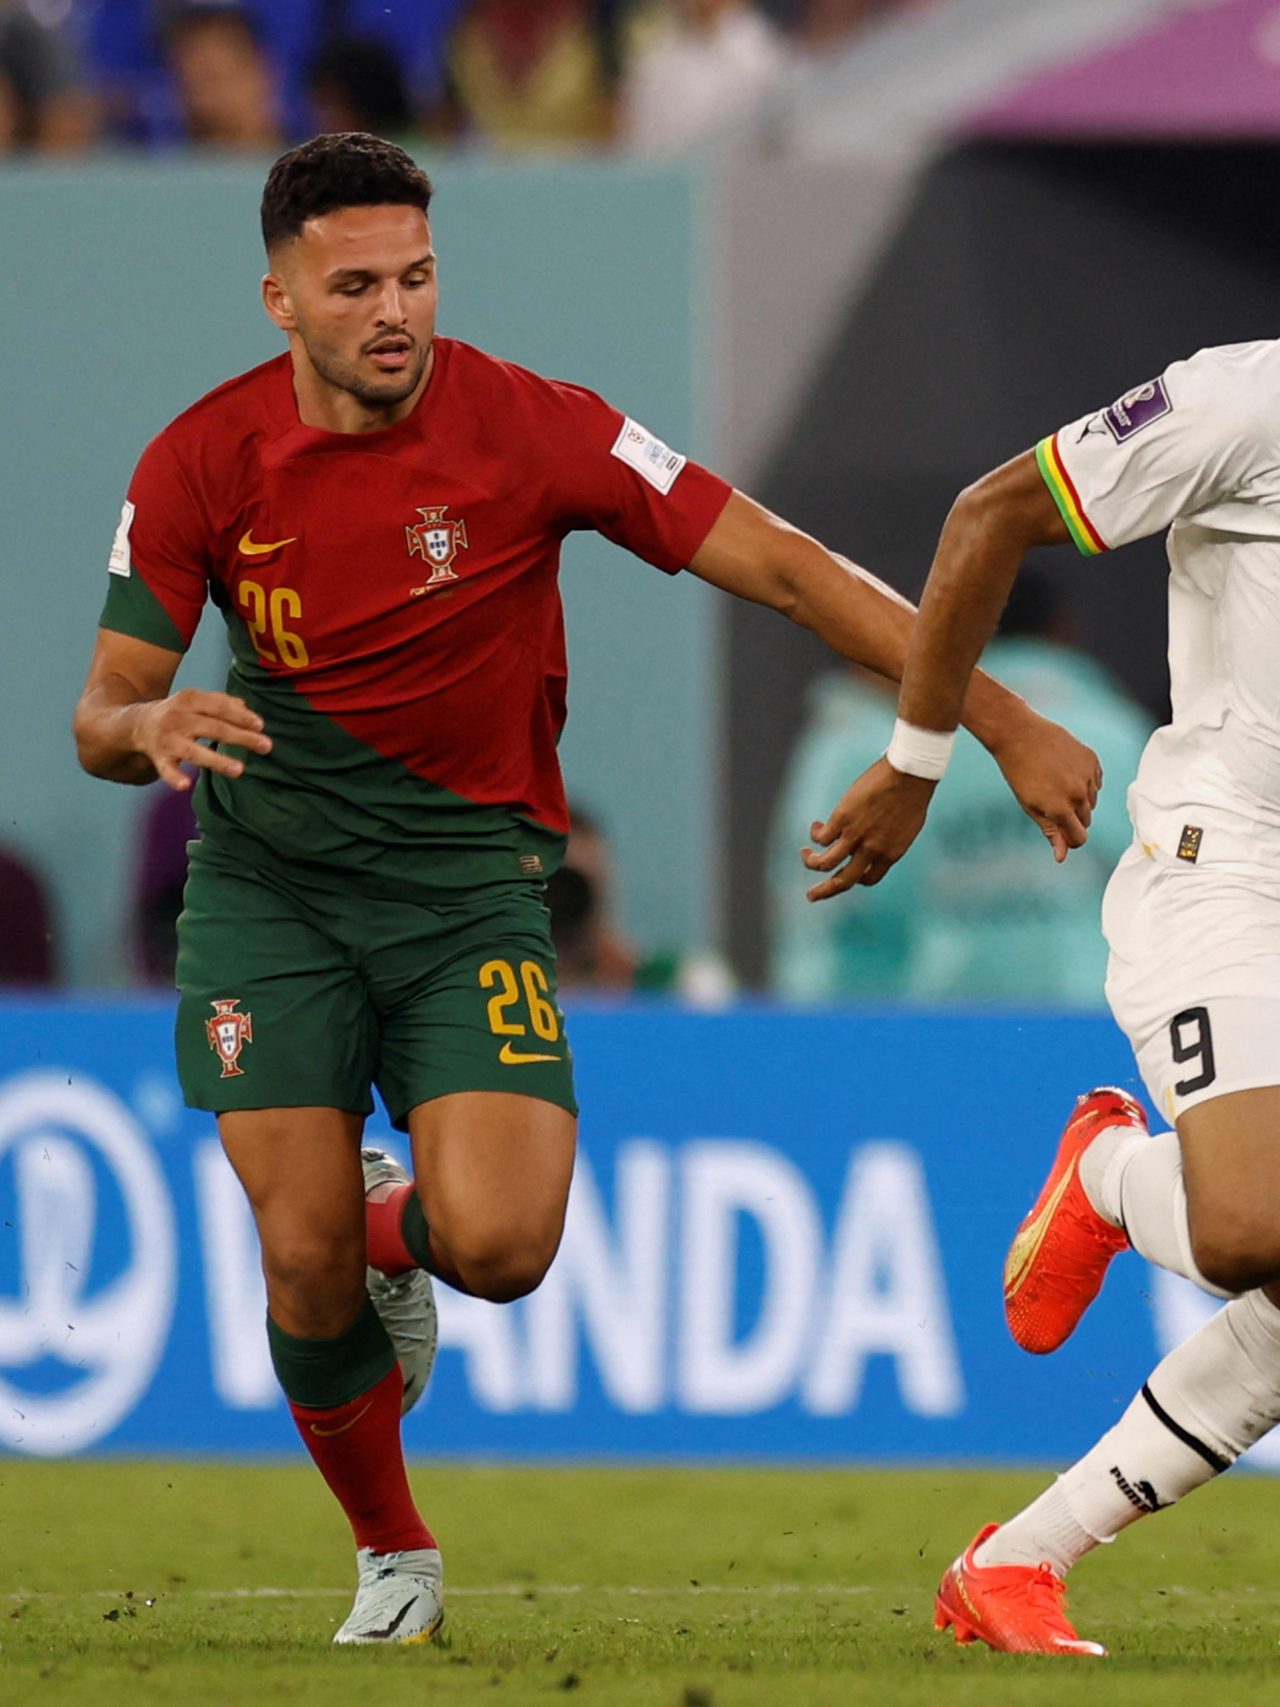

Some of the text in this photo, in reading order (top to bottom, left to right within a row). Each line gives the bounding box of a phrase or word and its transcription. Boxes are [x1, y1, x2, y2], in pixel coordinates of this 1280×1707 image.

[238, 580, 309, 669] 26
[479, 960, 558, 1042] 26
[1170, 1006, 1216, 1096] 9
[1110, 1466, 1153, 1513] PUMA
